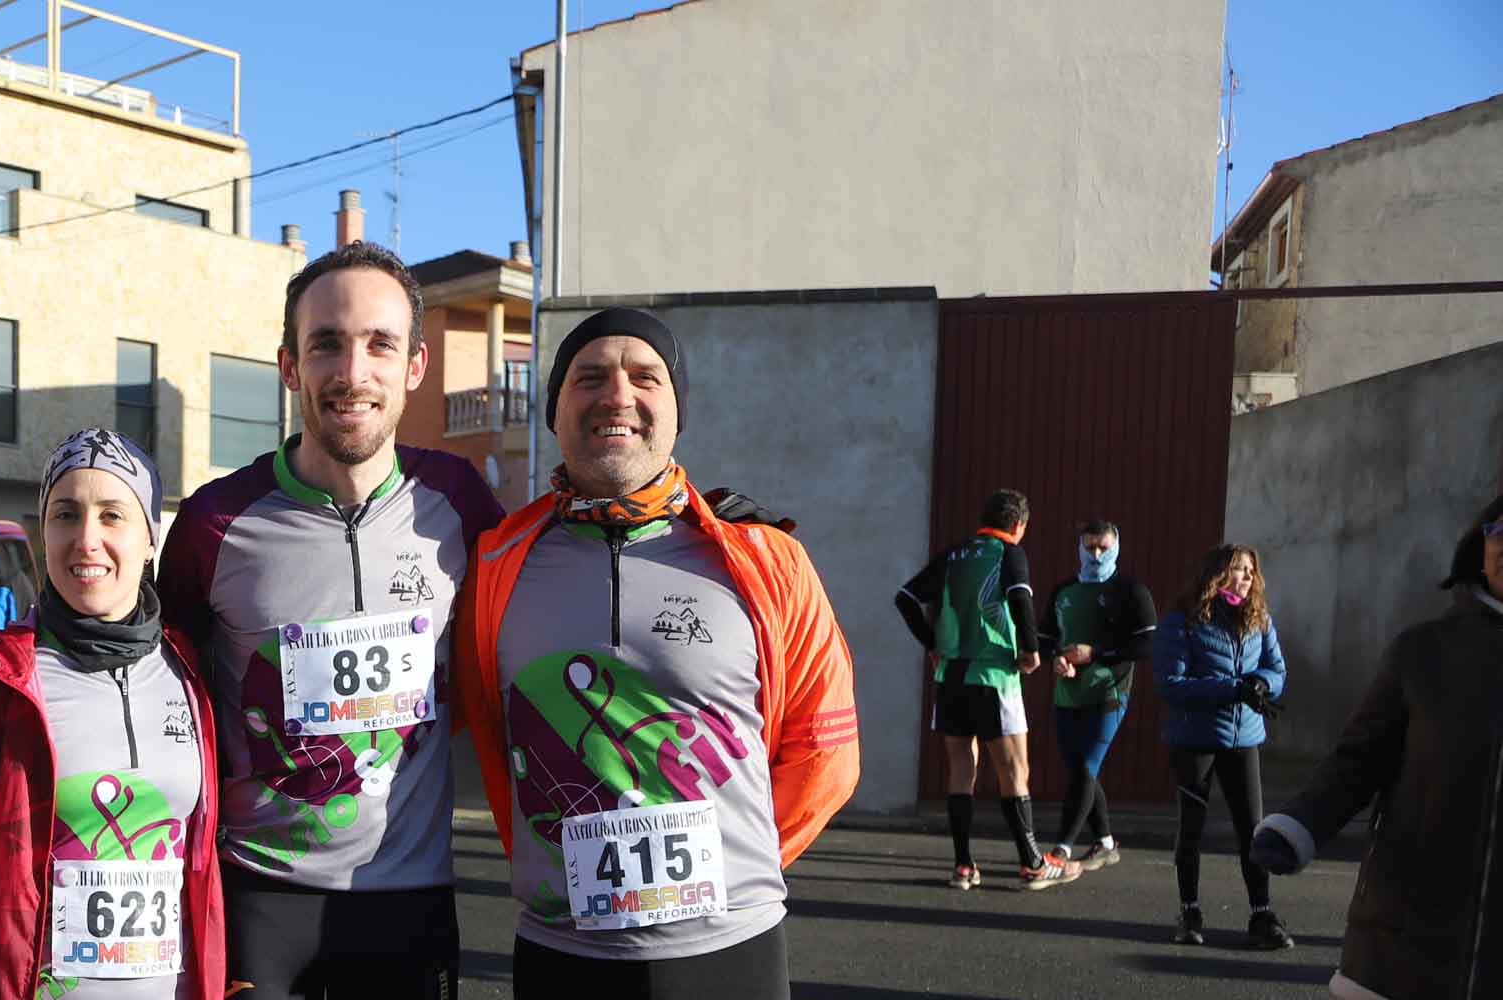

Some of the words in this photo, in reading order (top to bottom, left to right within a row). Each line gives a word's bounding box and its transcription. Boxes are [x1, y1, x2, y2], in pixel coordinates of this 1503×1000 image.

[316, 631, 338, 648] LIGA
[340, 625, 371, 645] CROSS
[372, 620, 413, 641] CABRERI
[333, 645, 391, 696] 83
[363, 714, 419, 729] REFORM
[594, 819, 616, 839] LIGA
[618, 815, 652, 836] CROSS
[597, 833, 693, 888] 415
[90, 870, 112, 887] LIGA
[580, 881, 716, 917] JOMISAGA
[647, 905, 716, 921] REFORMAS
[87, 890, 166, 938] 623
